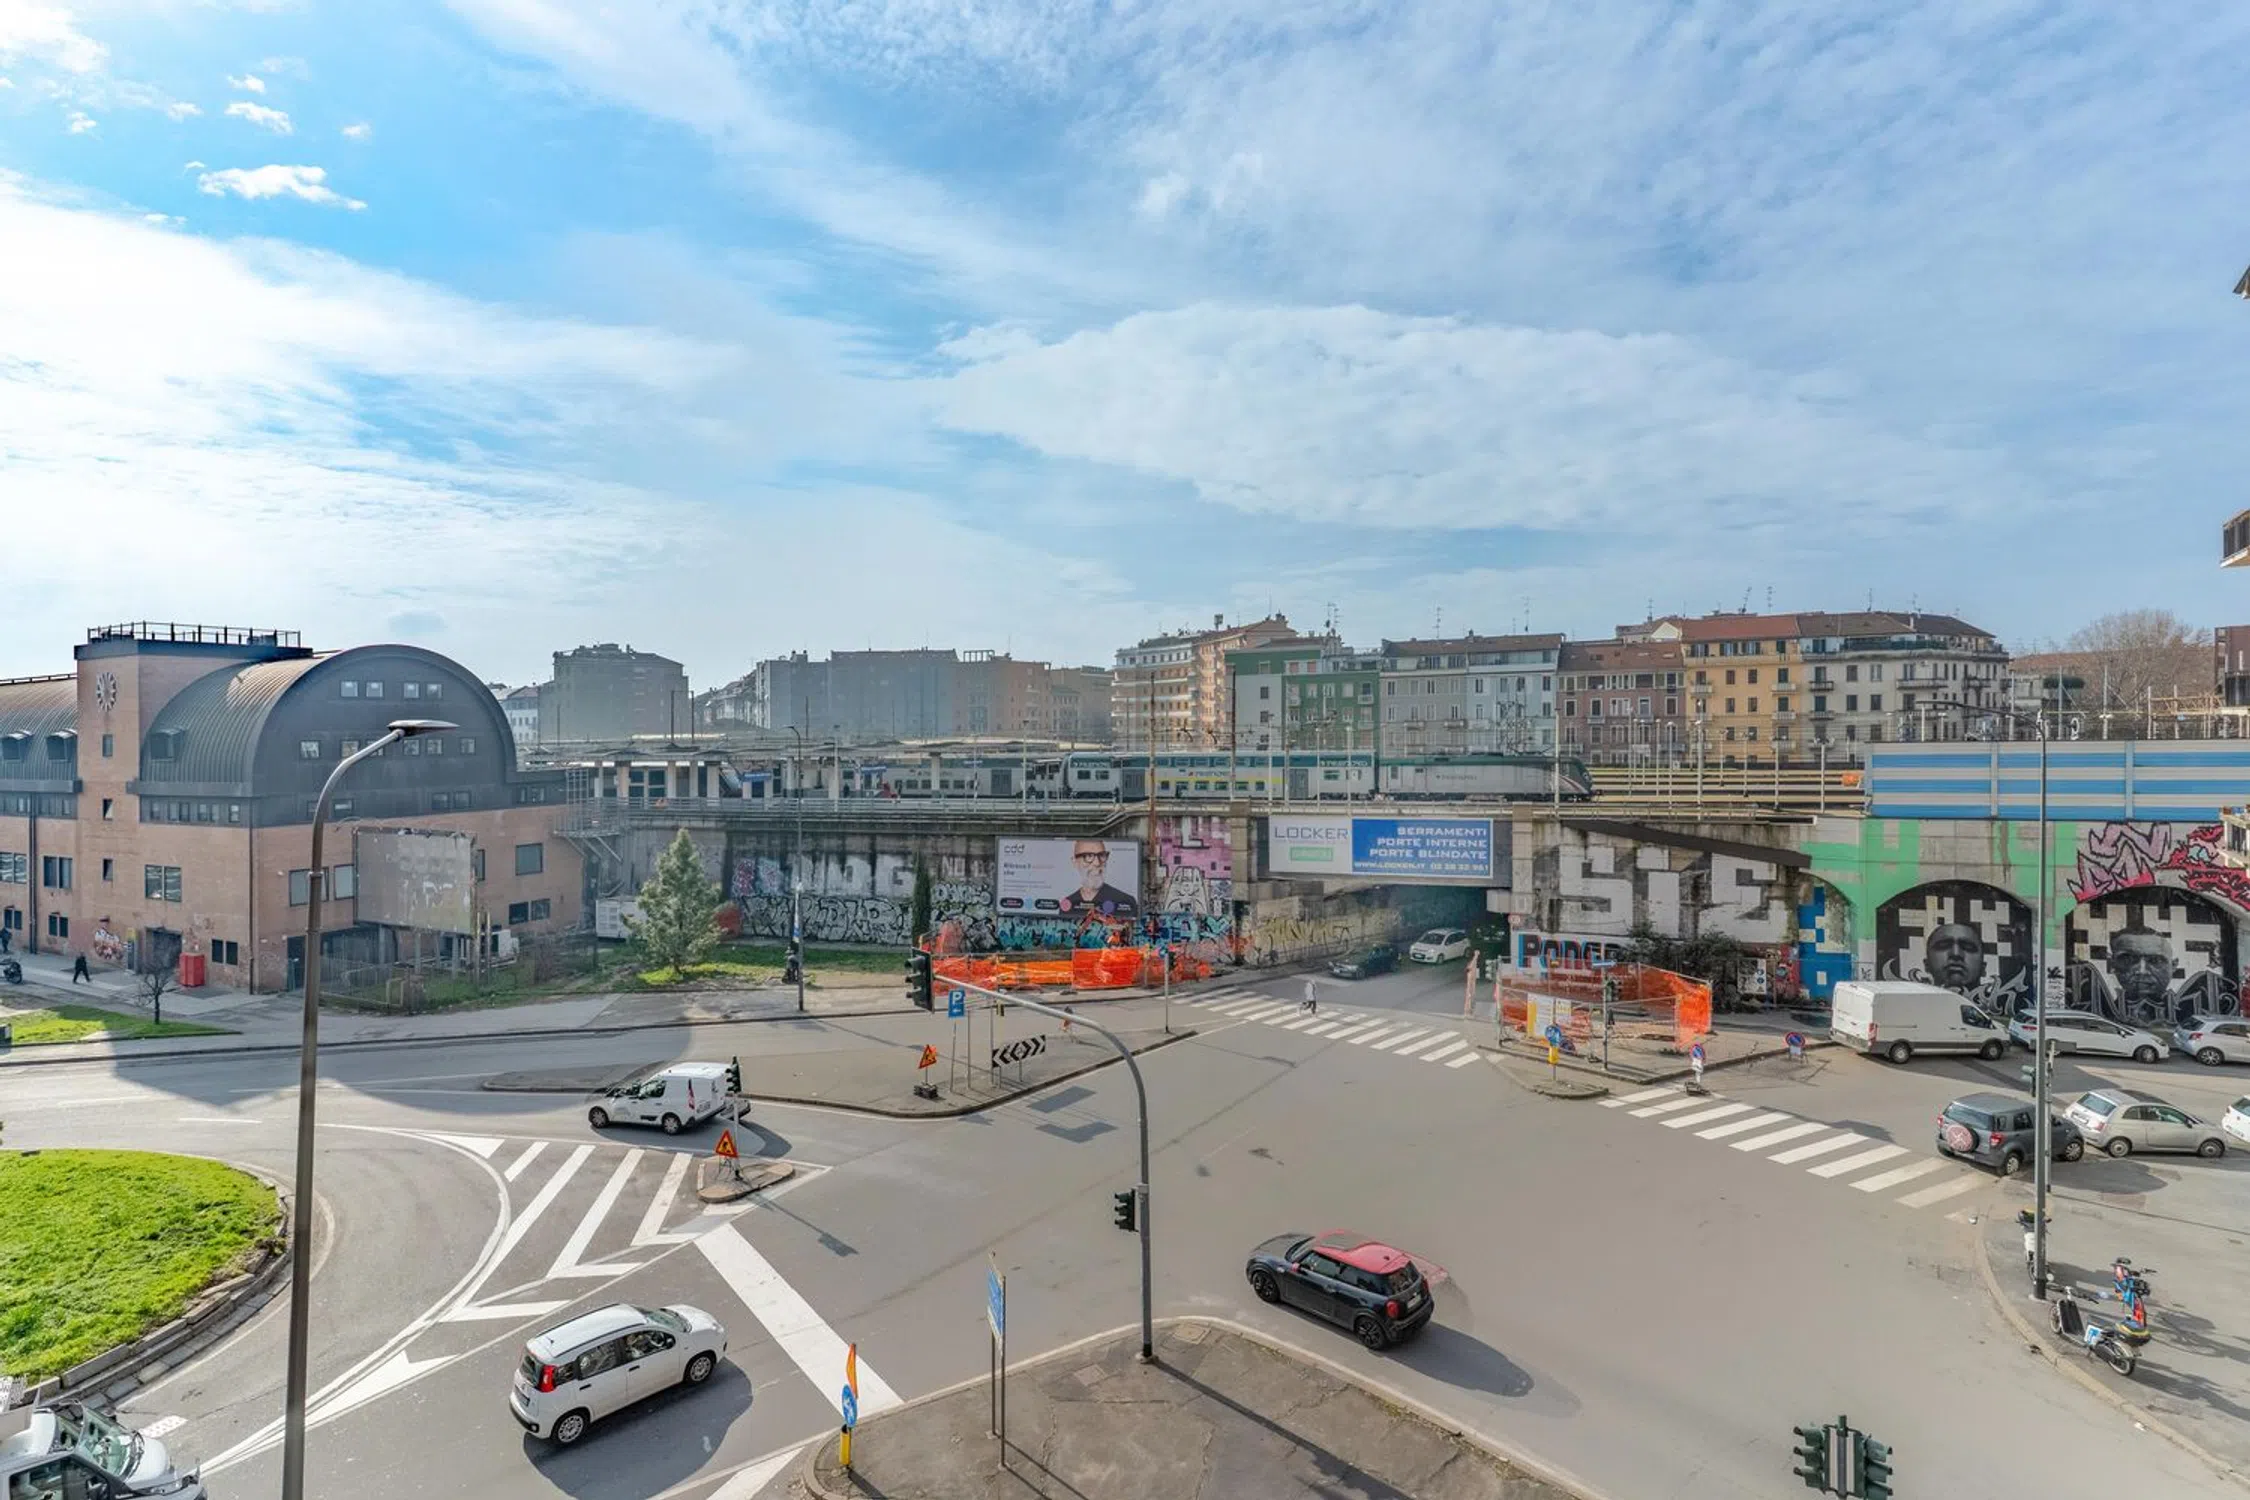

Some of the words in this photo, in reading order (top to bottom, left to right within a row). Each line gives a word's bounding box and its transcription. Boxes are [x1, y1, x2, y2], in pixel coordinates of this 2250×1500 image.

[1274, 826, 1349, 839] LOCKER
[1397, 827, 1487, 836] SERRAMENTI
[1377, 838, 1421, 847] PORTE
[1426, 838, 1487, 848] INTERNE
[1369, 848, 1414, 858] PORTE
[1418, 849, 1487, 859] BLINDATE
[952, 991, 963, 1005] P
